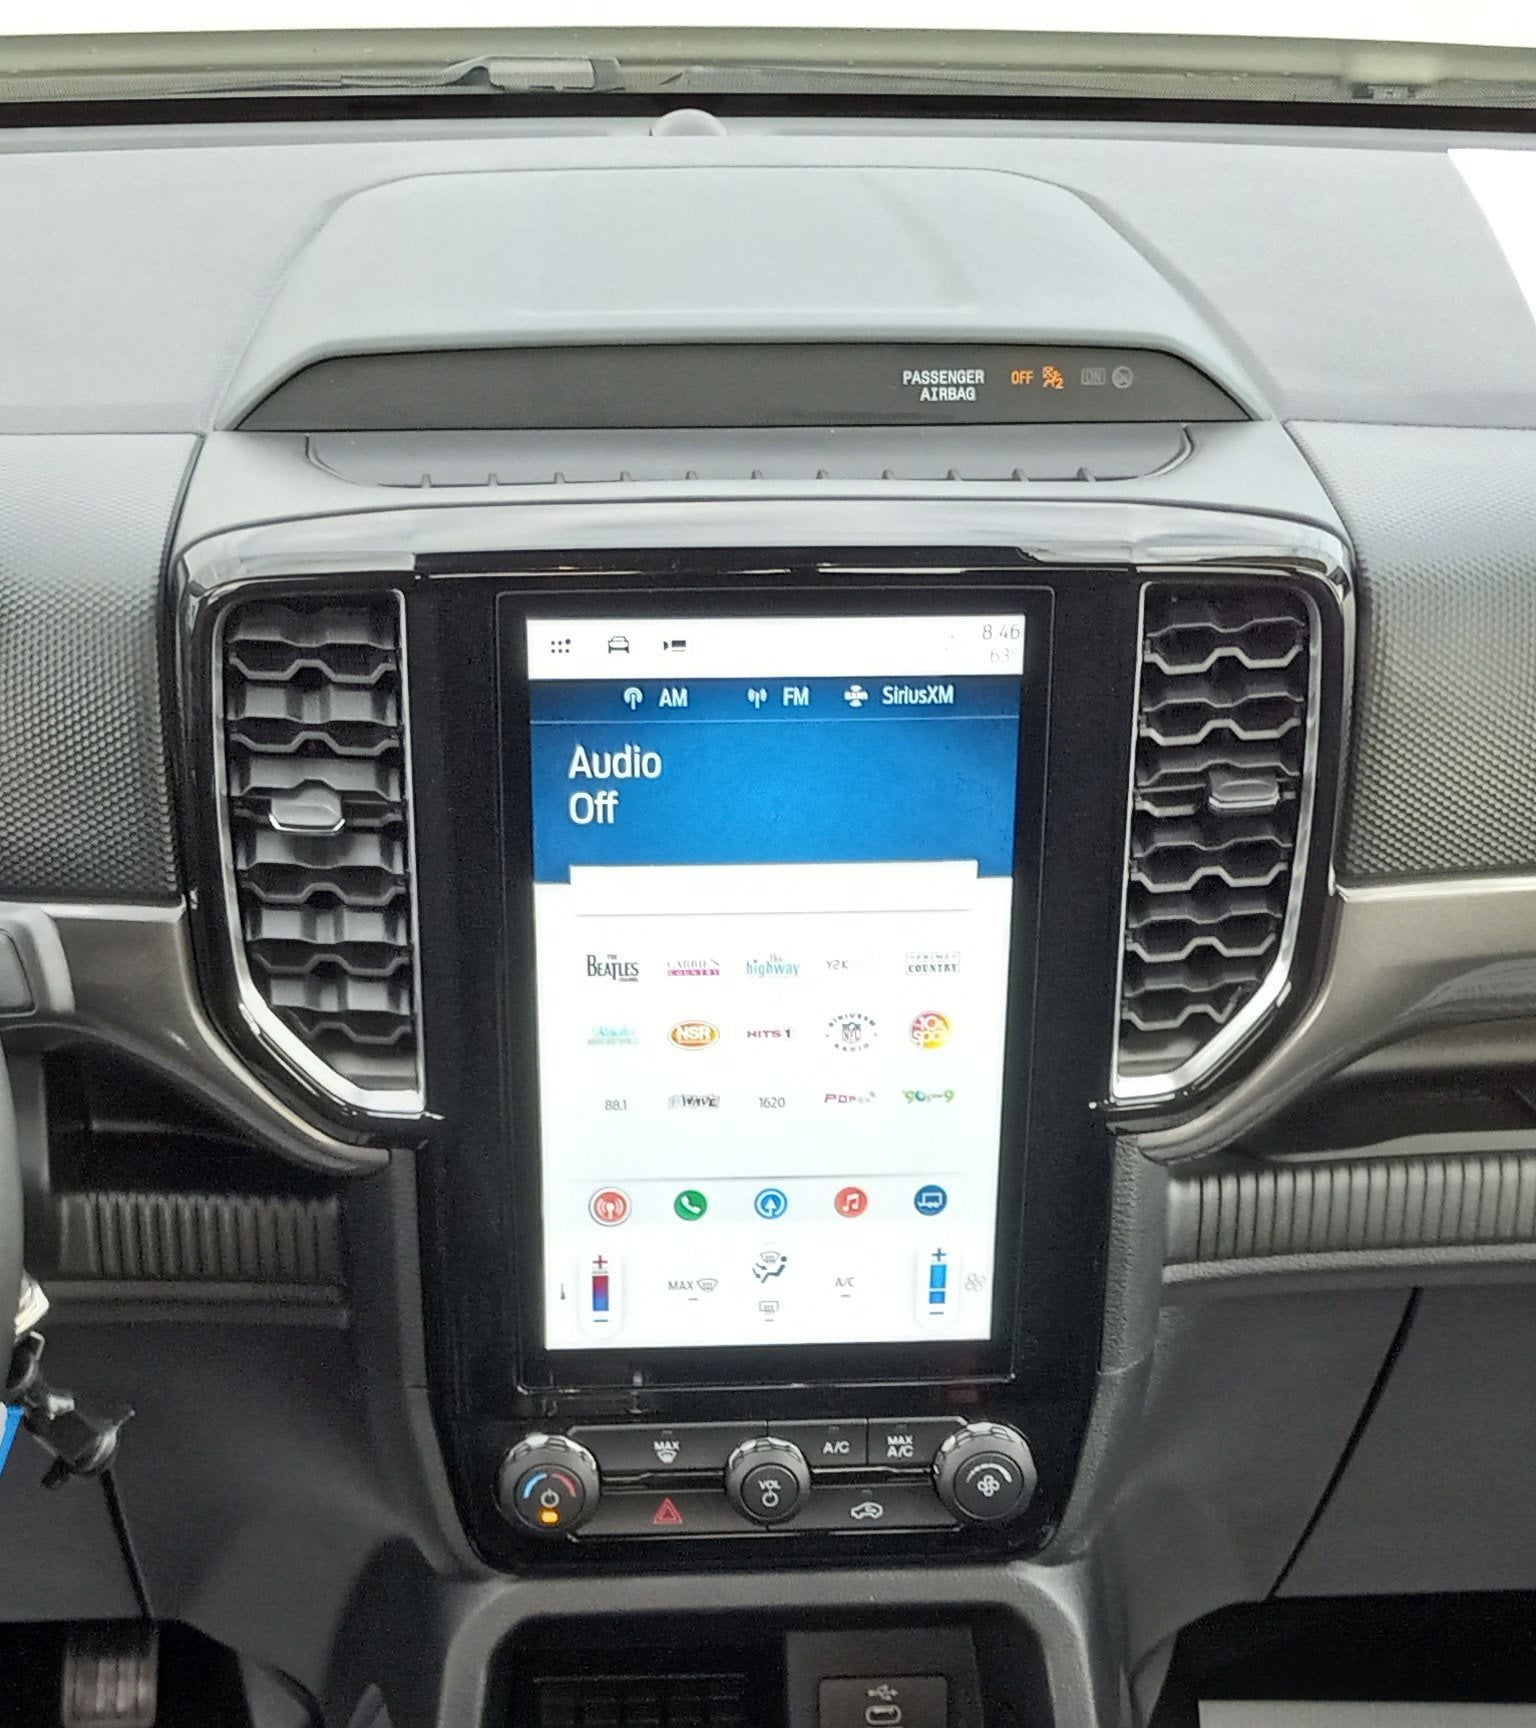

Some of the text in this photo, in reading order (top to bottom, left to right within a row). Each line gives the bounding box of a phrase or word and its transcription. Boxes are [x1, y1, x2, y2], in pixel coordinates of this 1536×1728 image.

[902, 368, 985, 385] PASSENGER
[1011, 370, 1034, 385] OFF
[920, 387, 976, 401] AIRBAG
[981, 623, 1021, 641] 846
[659, 685, 955, 707] AM FM SiriusXM
[568, 744, 663, 780] Audio
[568, 790, 620, 825] Off
[586, 954, 639, 981] BEATLES
[745, 959, 800, 978] highway
[908, 963, 958, 973] COUNTRY
[747, 1029, 782, 1039] HITS
[759, 1097, 785, 1109] 1620
[668, 1280, 695, 1291] MAX
[654, 1440, 680, 1451] MAX
[822, 1441, 851, 1455] A/C
[887, 1436, 913, 1446] MAX
[886, 1446, 913, 1458] A/C
[758, 1479, 781, 1490] VOL
